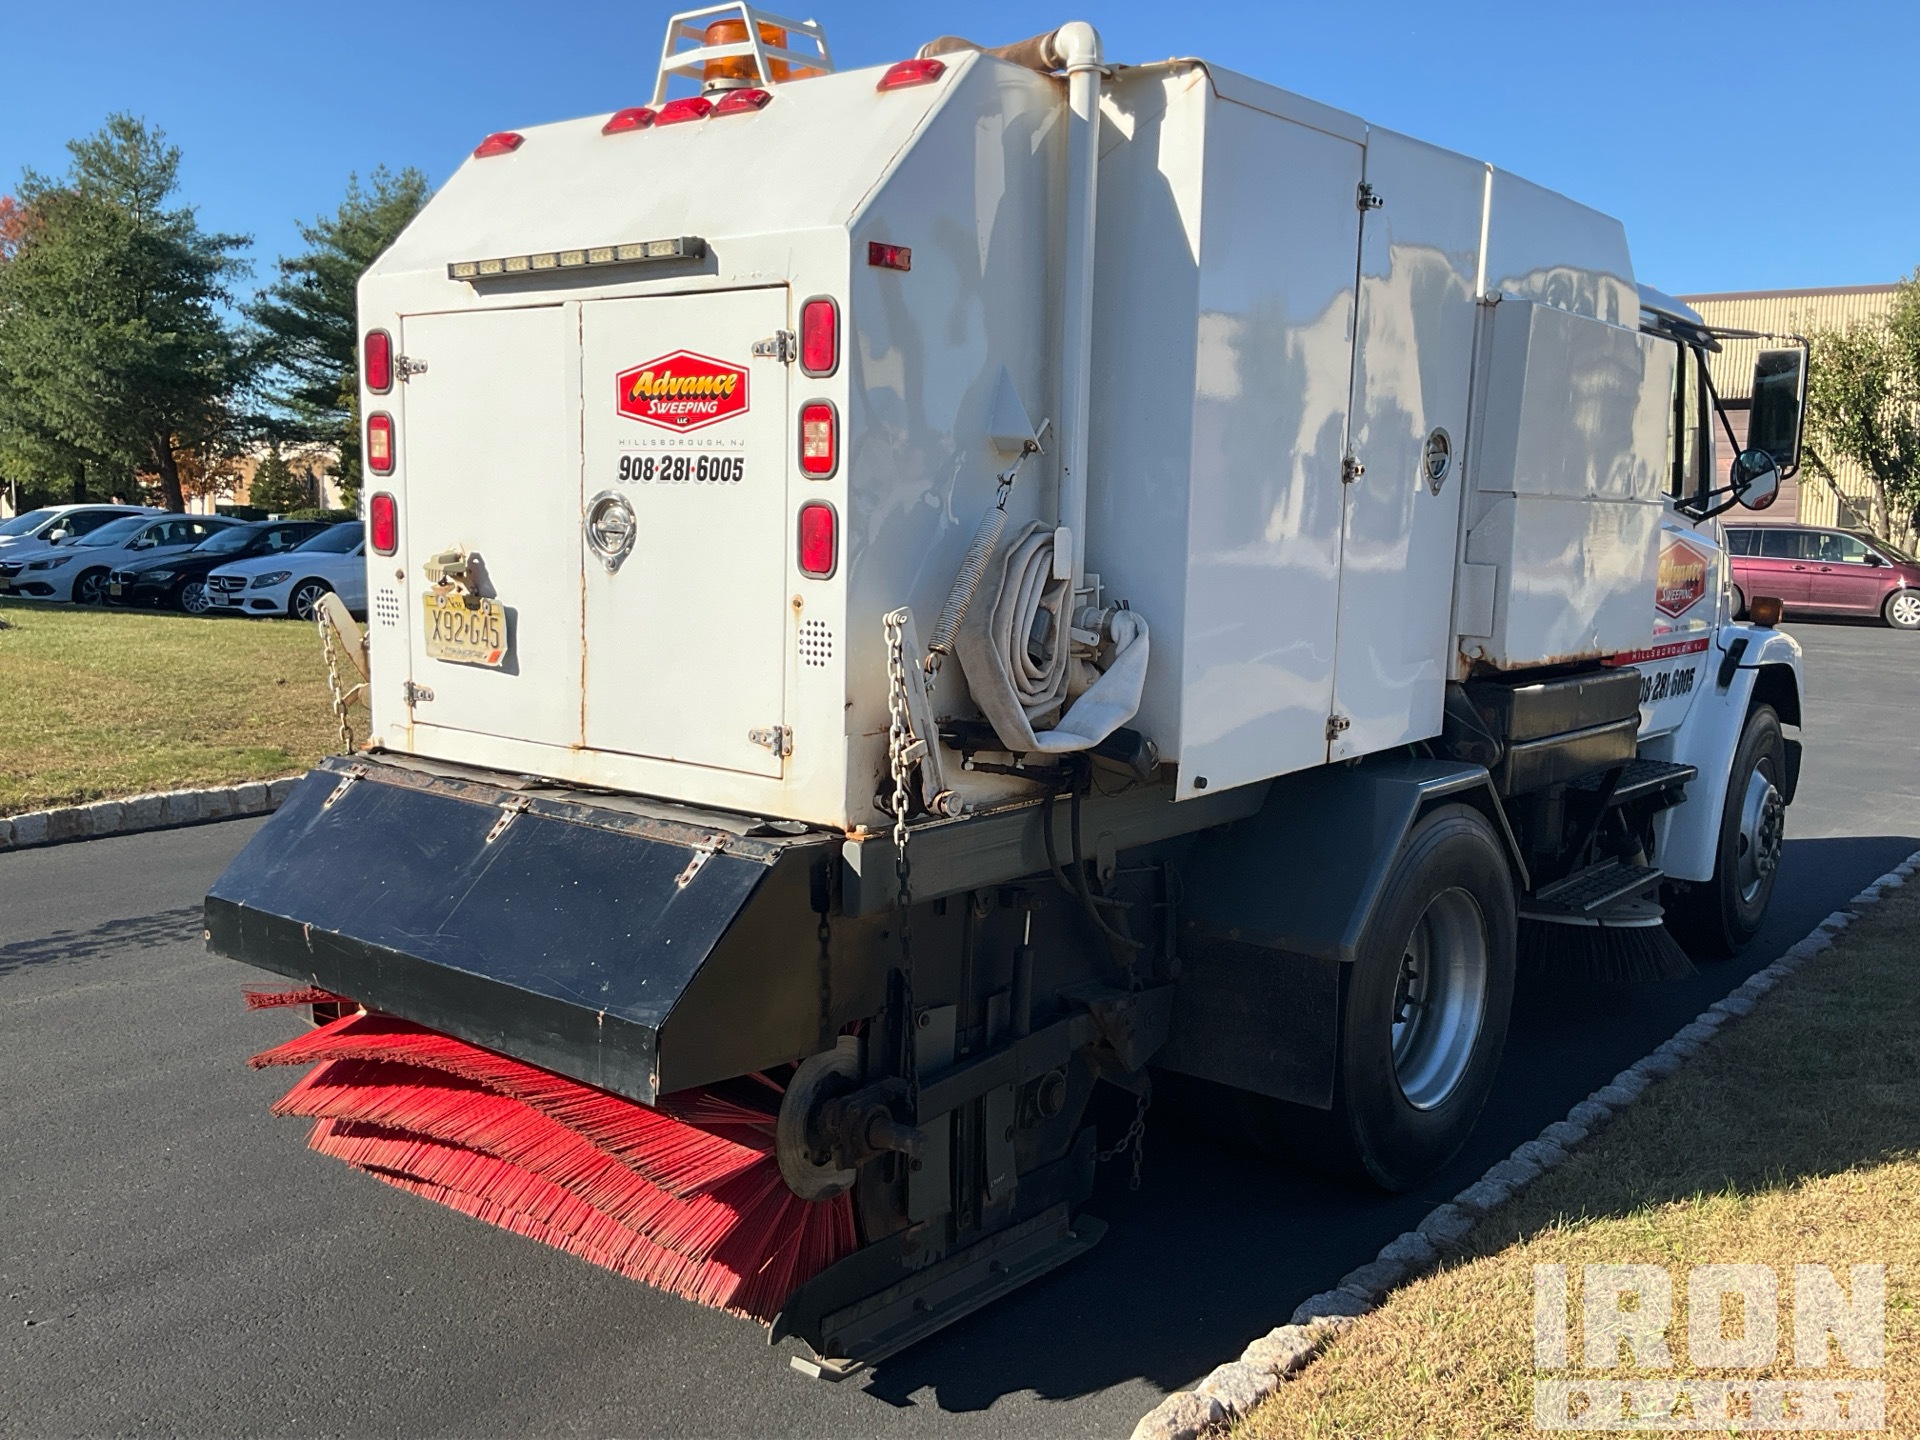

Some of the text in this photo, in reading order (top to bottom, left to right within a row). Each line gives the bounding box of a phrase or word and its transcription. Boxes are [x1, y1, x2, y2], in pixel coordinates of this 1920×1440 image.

[630, 371, 738, 401] Advance
[647, 400, 718, 414] SWEEPING
[619, 439, 725, 447] HILLSBOROUGH,
[1660, 588, 1694, 601] SWEEPING
